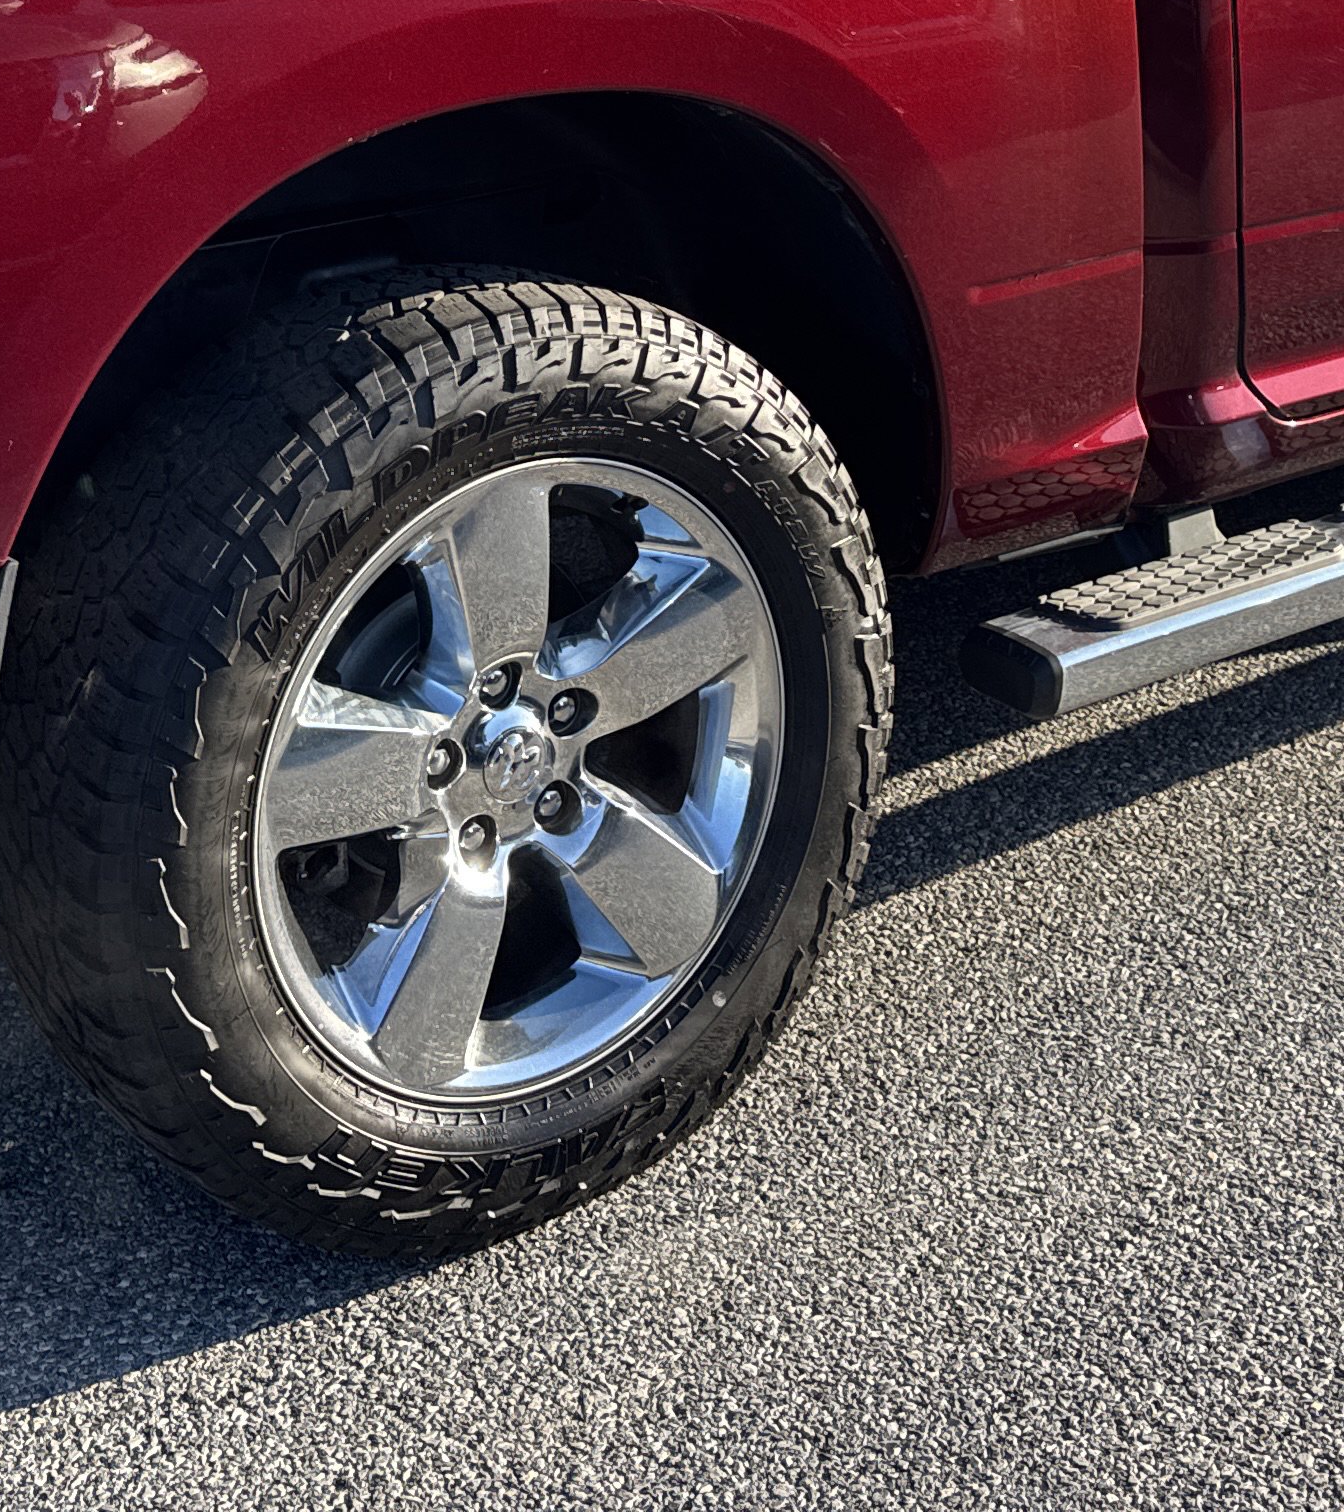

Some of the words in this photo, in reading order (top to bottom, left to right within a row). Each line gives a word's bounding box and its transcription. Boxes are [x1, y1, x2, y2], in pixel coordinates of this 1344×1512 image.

[254, 384, 653, 661] WILDPEAK
[649, 396, 771, 468] A/T
[316, 1076, 666, 1194] FALKEN
